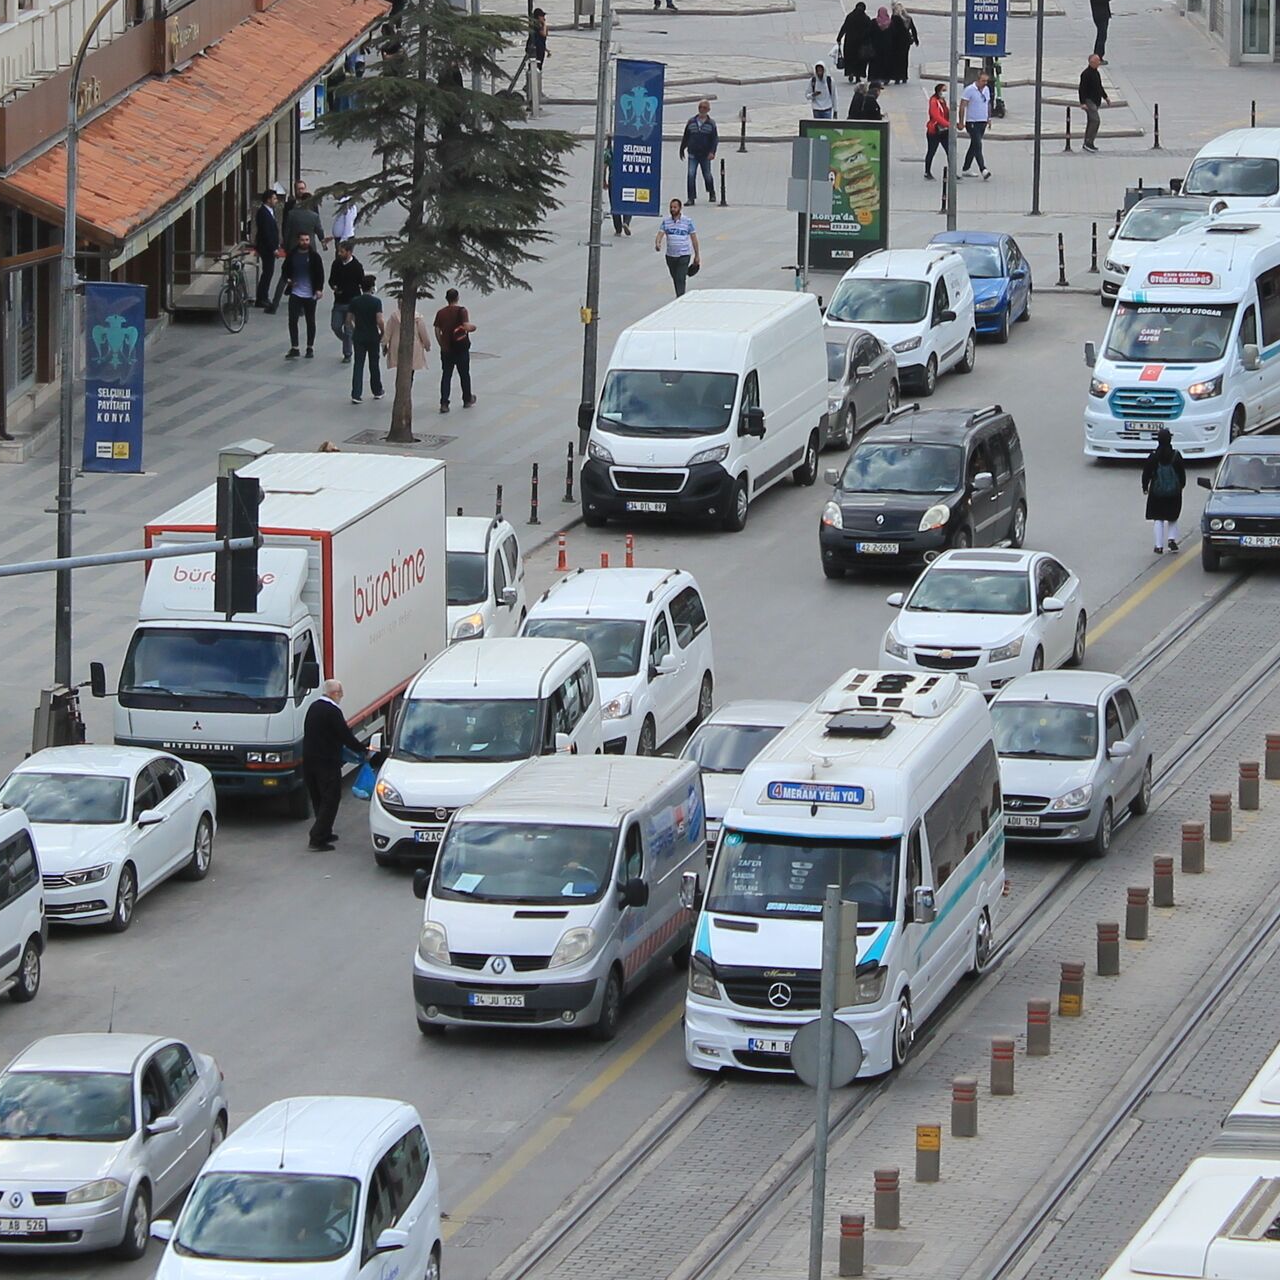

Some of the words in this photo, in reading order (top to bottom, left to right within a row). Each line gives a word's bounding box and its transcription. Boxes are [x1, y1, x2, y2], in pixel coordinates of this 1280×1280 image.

[622, 165, 652, 174] KONYA
[97, 388, 131, 401] SELÇUKLU
[96, 413, 131, 423] KONYA
[353, 548, 426, 624] bürotime
[163, 741, 235, 751] MITSUBISHI
[774, 782, 782, 799] 4
[782, 786, 818, 801] MERAM
[841, 788, 859, 803] YOL
[474, 995, 485, 1005] 34
[754, 1040, 764, 1050] 42
